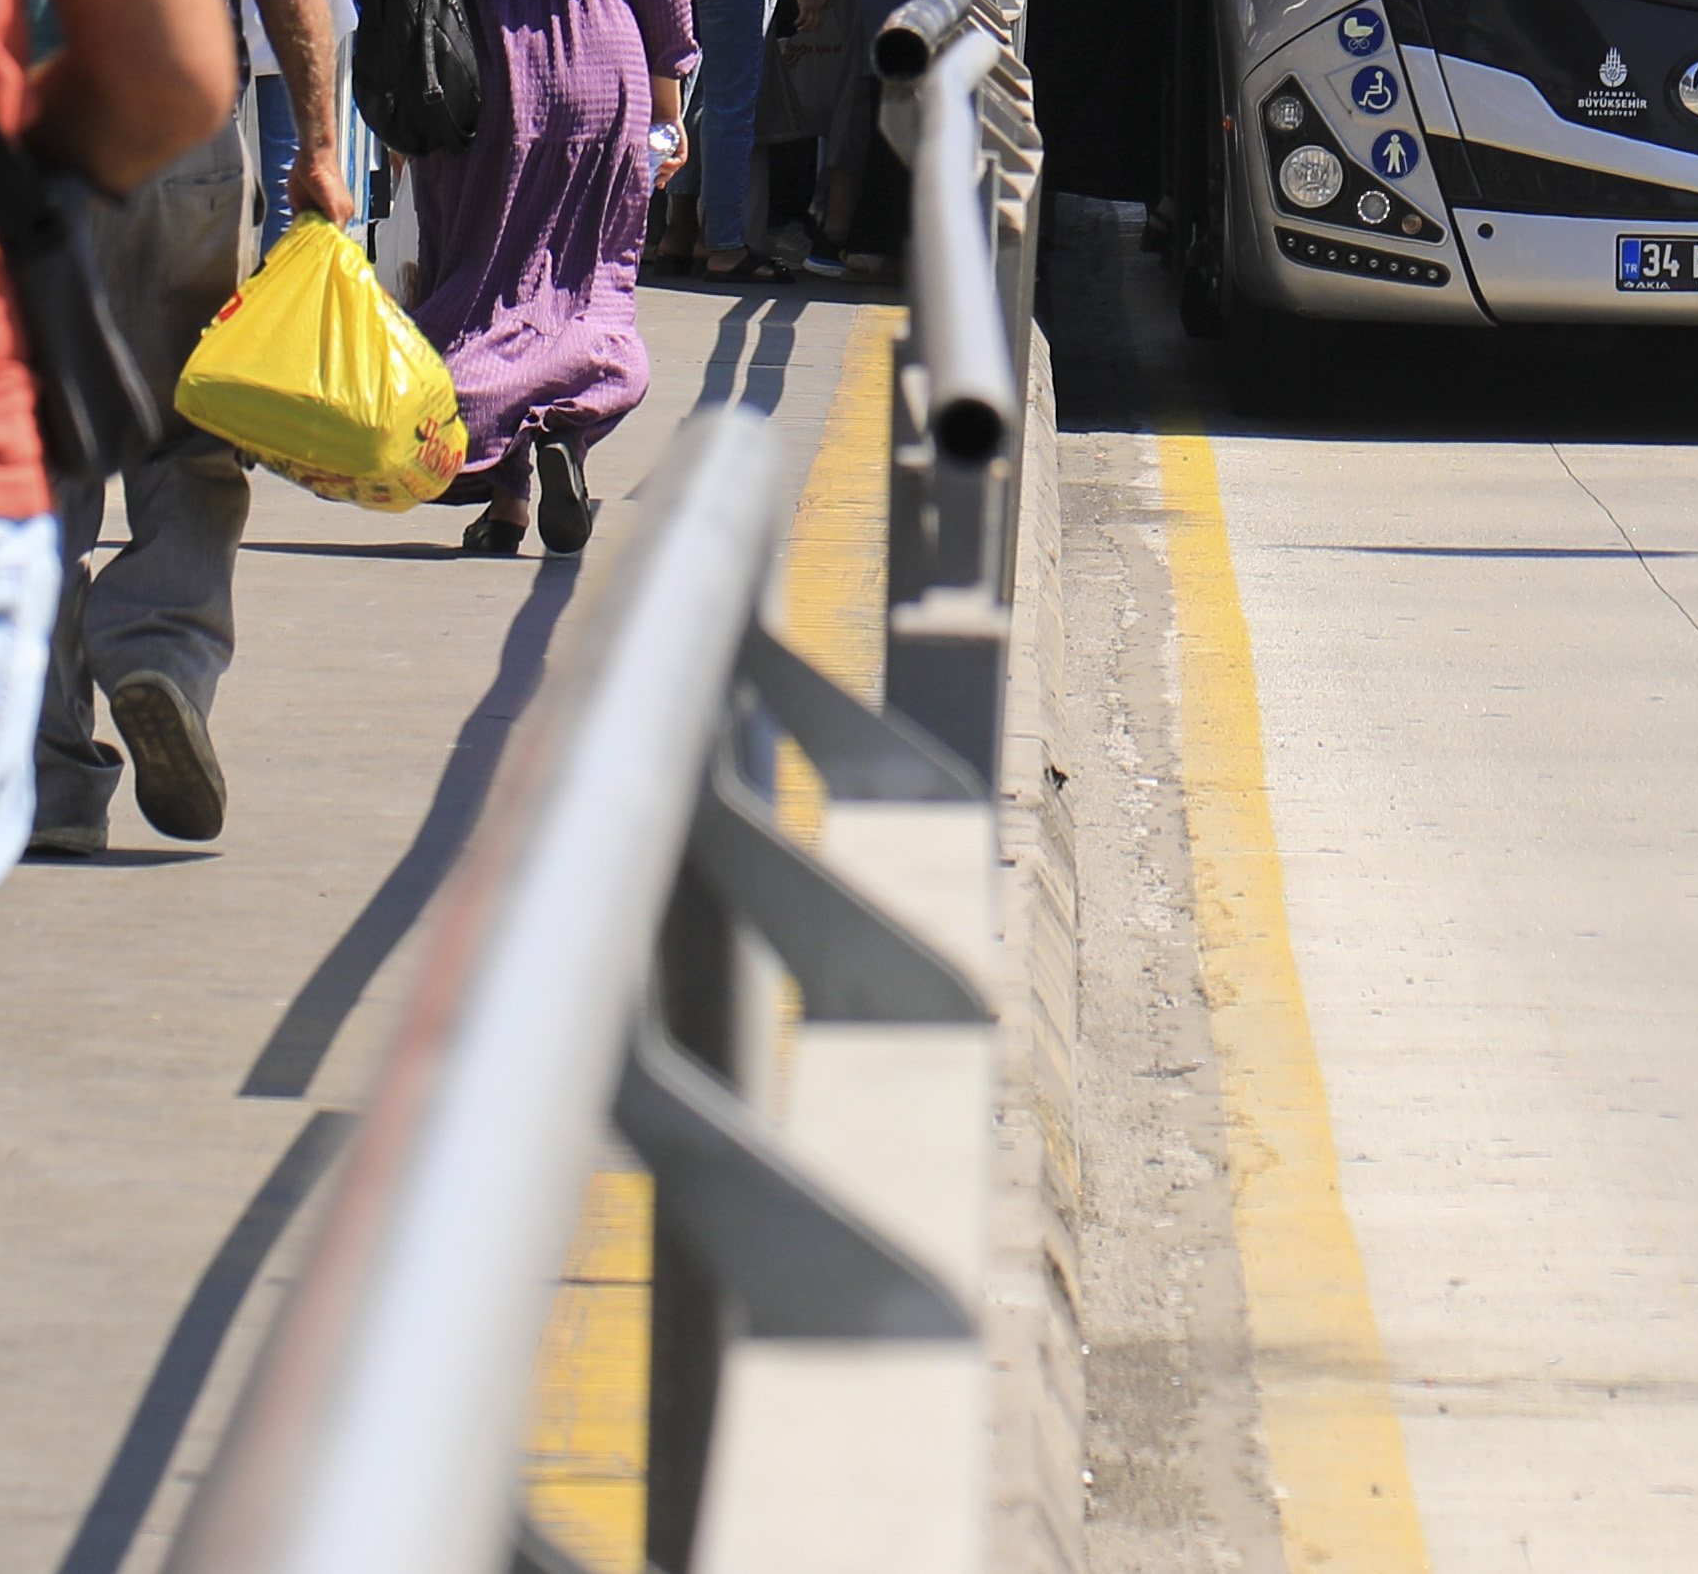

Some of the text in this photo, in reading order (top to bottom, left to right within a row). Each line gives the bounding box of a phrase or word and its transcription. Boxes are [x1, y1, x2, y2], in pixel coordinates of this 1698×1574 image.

[1577, 98, 1648, 109] BÜYÜKŞEHİR
[1642, 243, 1680, 278] 34
[1624, 263, 1638, 273] TR
[1635, 281, 1671, 290] AKIA
